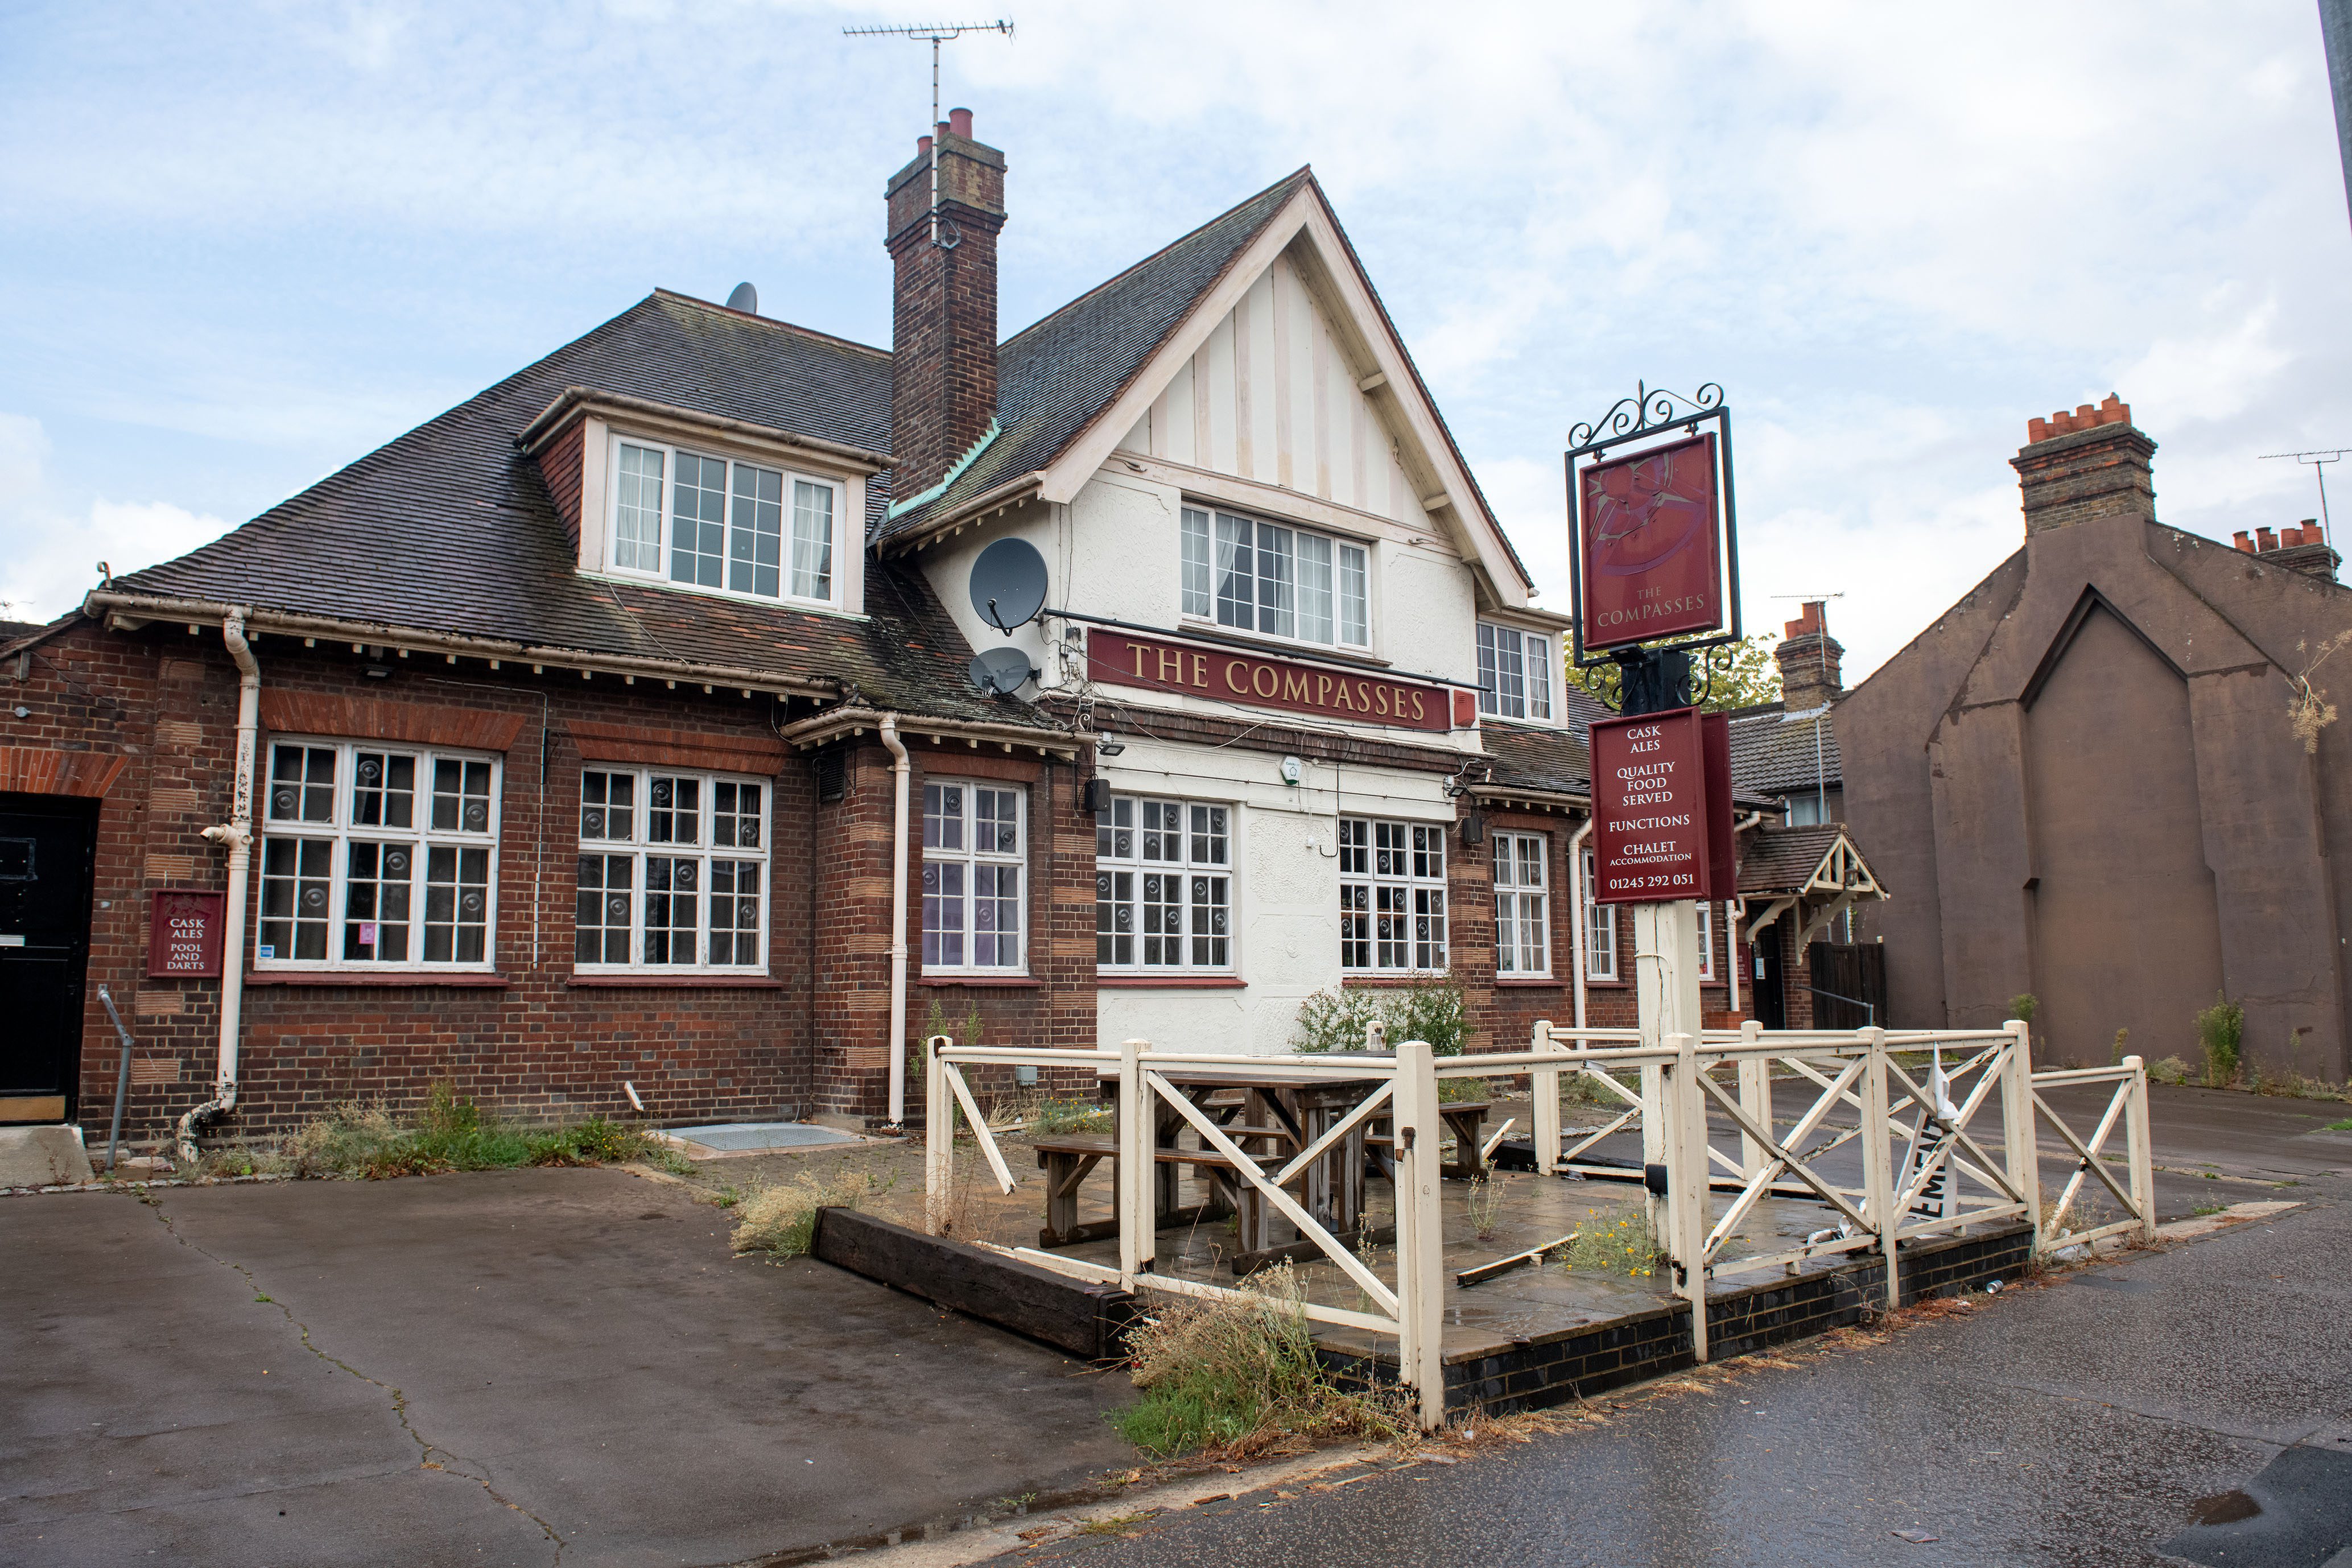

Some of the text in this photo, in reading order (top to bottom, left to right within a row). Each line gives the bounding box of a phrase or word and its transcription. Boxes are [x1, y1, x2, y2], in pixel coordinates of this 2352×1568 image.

[1637, 586, 1661, 600] THE
[1598, 594, 1704, 626] COMPASSES
[1127, 643, 1424, 721] THE COMPASSES
[1627, 725, 1661, 739] CASK
[1630, 740, 1660, 753] ALES
[1617, 762, 1675, 779] QUALITY
[1627, 777, 1666, 791] FOOD
[1623, 791, 1673, 806] SERVED
[1609, 814, 1690, 832] FUNCTIONS
[1623, 841, 1676, 855] CHALET
[1610, 853, 1691, 866] ACCOMMODATION
[1610, 874, 1694, 889] 01245 292 051
[170, 918, 205, 928] CASK
[172, 929, 203, 938] ALES
